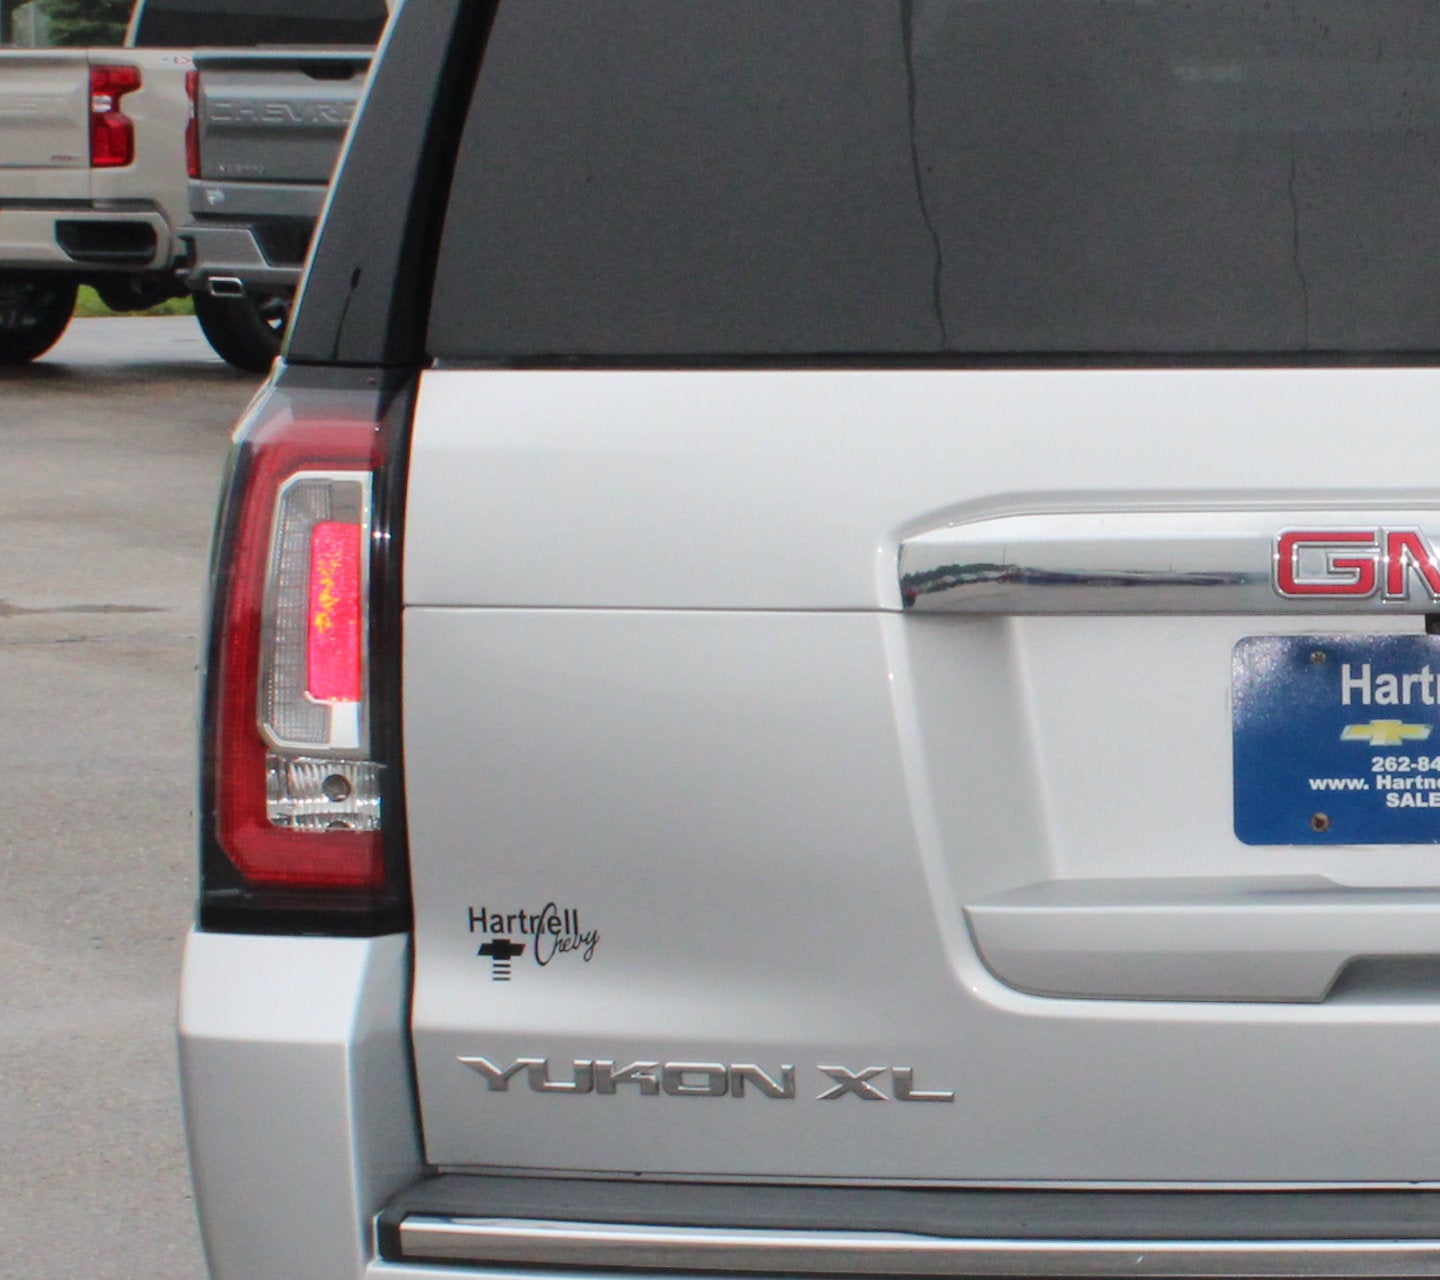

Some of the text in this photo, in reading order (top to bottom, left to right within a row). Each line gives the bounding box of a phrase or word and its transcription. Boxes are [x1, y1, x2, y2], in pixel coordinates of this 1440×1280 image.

[1308, 777, 1370, 791] www.
[468, 906, 580, 935] Hartnell
[534, 901, 602, 967] Chevy
[456, 1055, 957, 1104] YUKON XL
